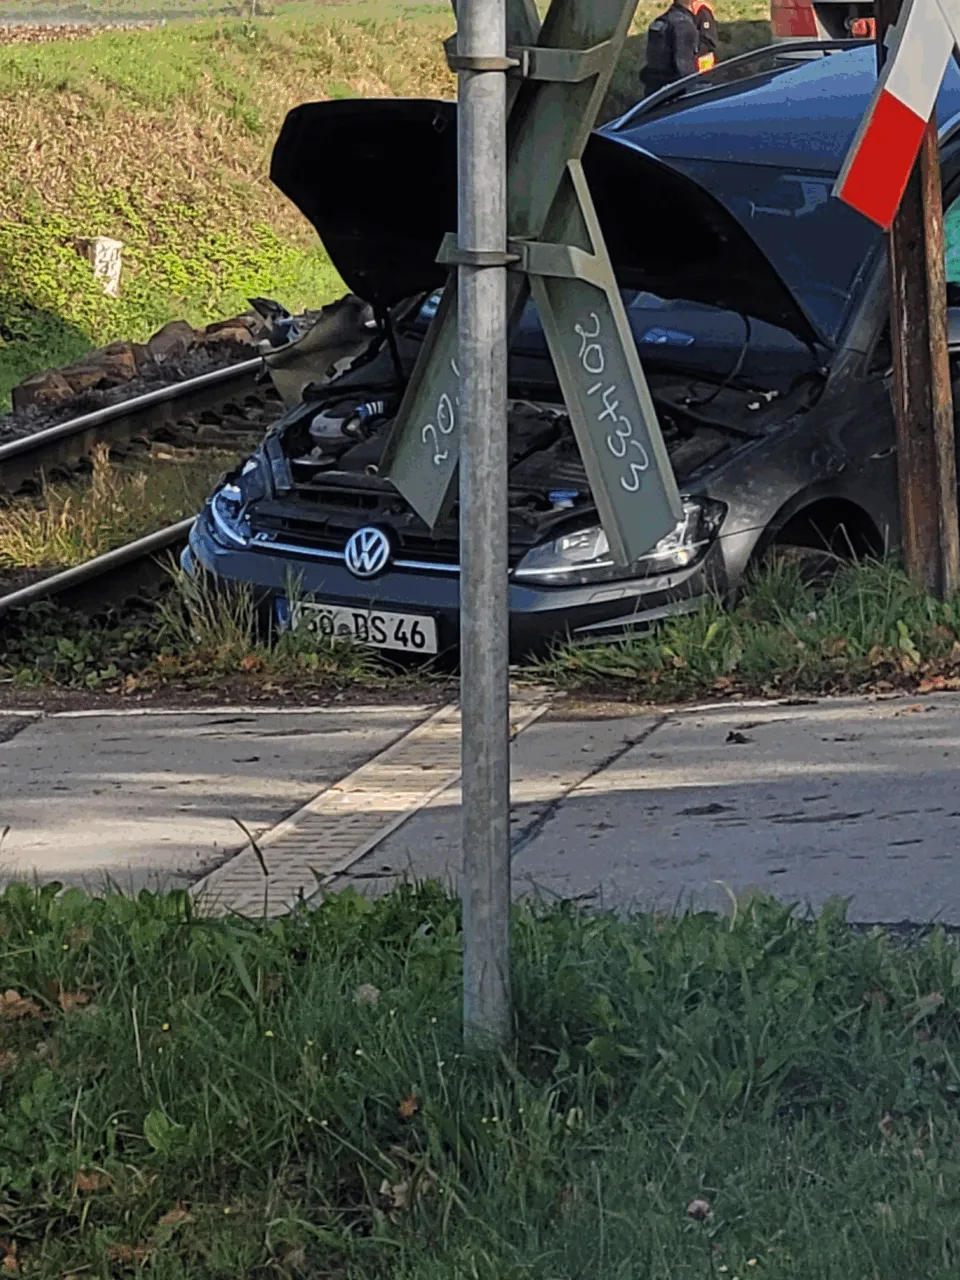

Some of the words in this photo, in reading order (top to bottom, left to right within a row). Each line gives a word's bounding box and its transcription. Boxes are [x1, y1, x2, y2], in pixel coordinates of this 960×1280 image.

[346, 527, 390, 576] VW
[352, 612, 388, 644] DS
[394, 618, 426, 649] 46
